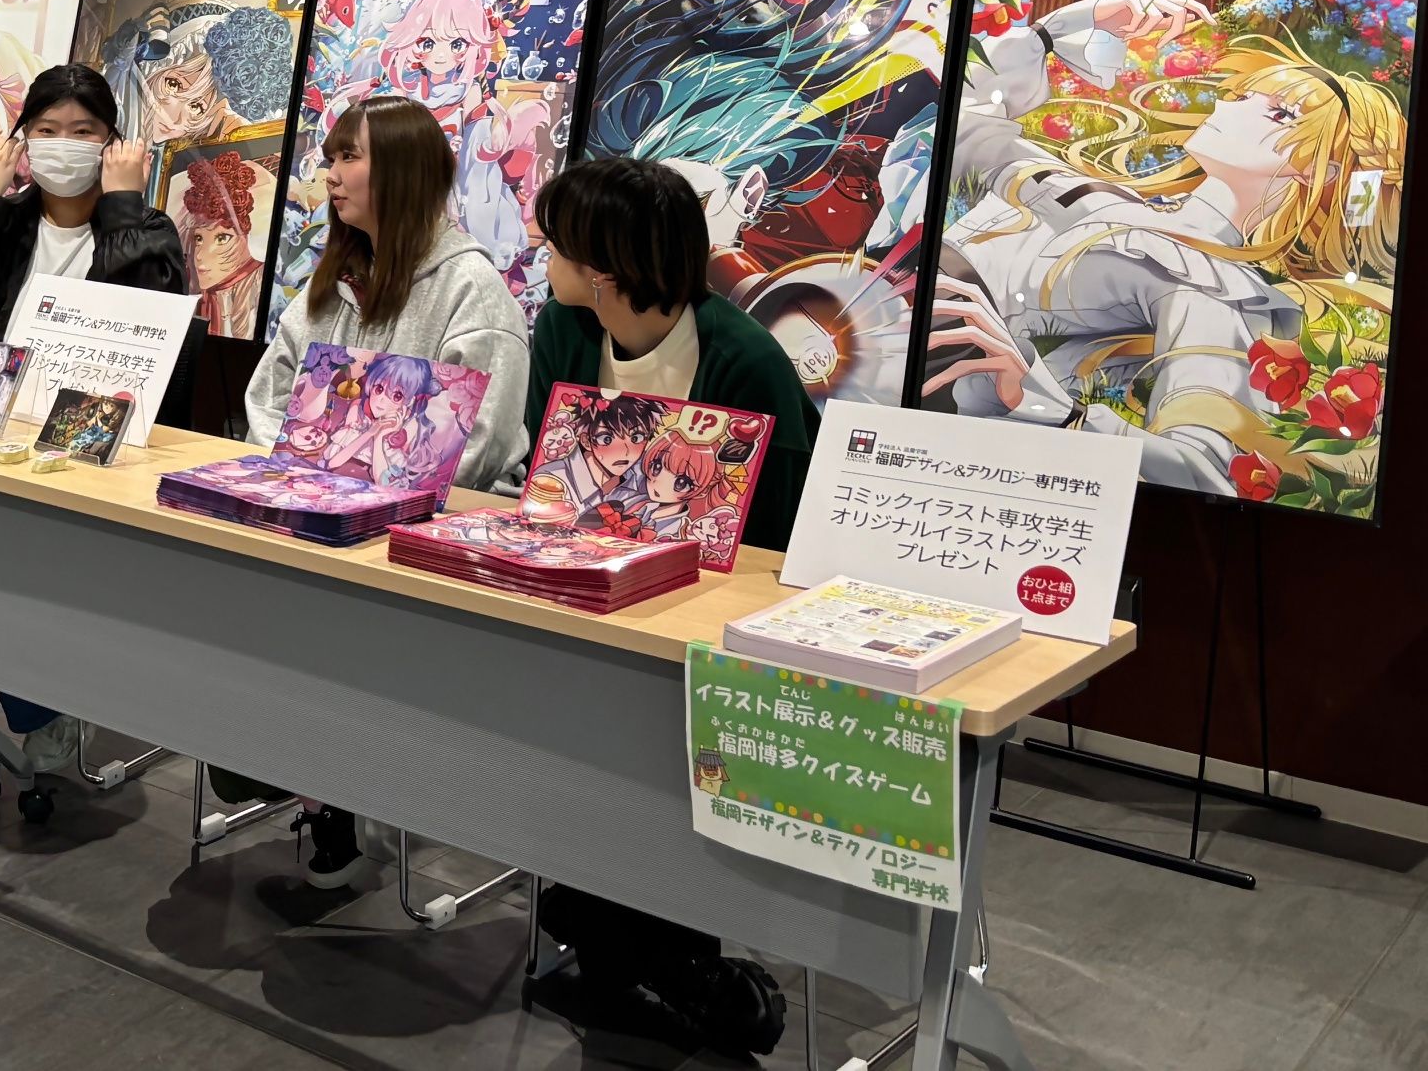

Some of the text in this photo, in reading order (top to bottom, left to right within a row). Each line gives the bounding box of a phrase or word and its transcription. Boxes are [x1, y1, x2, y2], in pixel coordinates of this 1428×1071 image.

[688, 409, 718, 436] !?
[874, 450, 1101, 497] 福岡デザイン&テクノロジー専門学校
[834, 483, 1094, 541] コミックイラスト専攻学生
[830, 508, 1087, 565] オリジナルイラストグッズ
[897, 542, 1000, 575] プレゼント
[1021, 574, 1072, 596] おひと組
[1021, 589, 1070, 609] 1点まで
[779, 684, 811, 700] てんじ
[695, 683, 948, 762] イラスト展示&グッズ販売
[710, 715, 806, 749] ふくおかはかた
[716, 730, 932, 806] 福岡博多クイズゲーム
[710, 797, 937, 872] 福岡デザイン&テクノロジー
[871, 867, 950, 905] 専門学校
